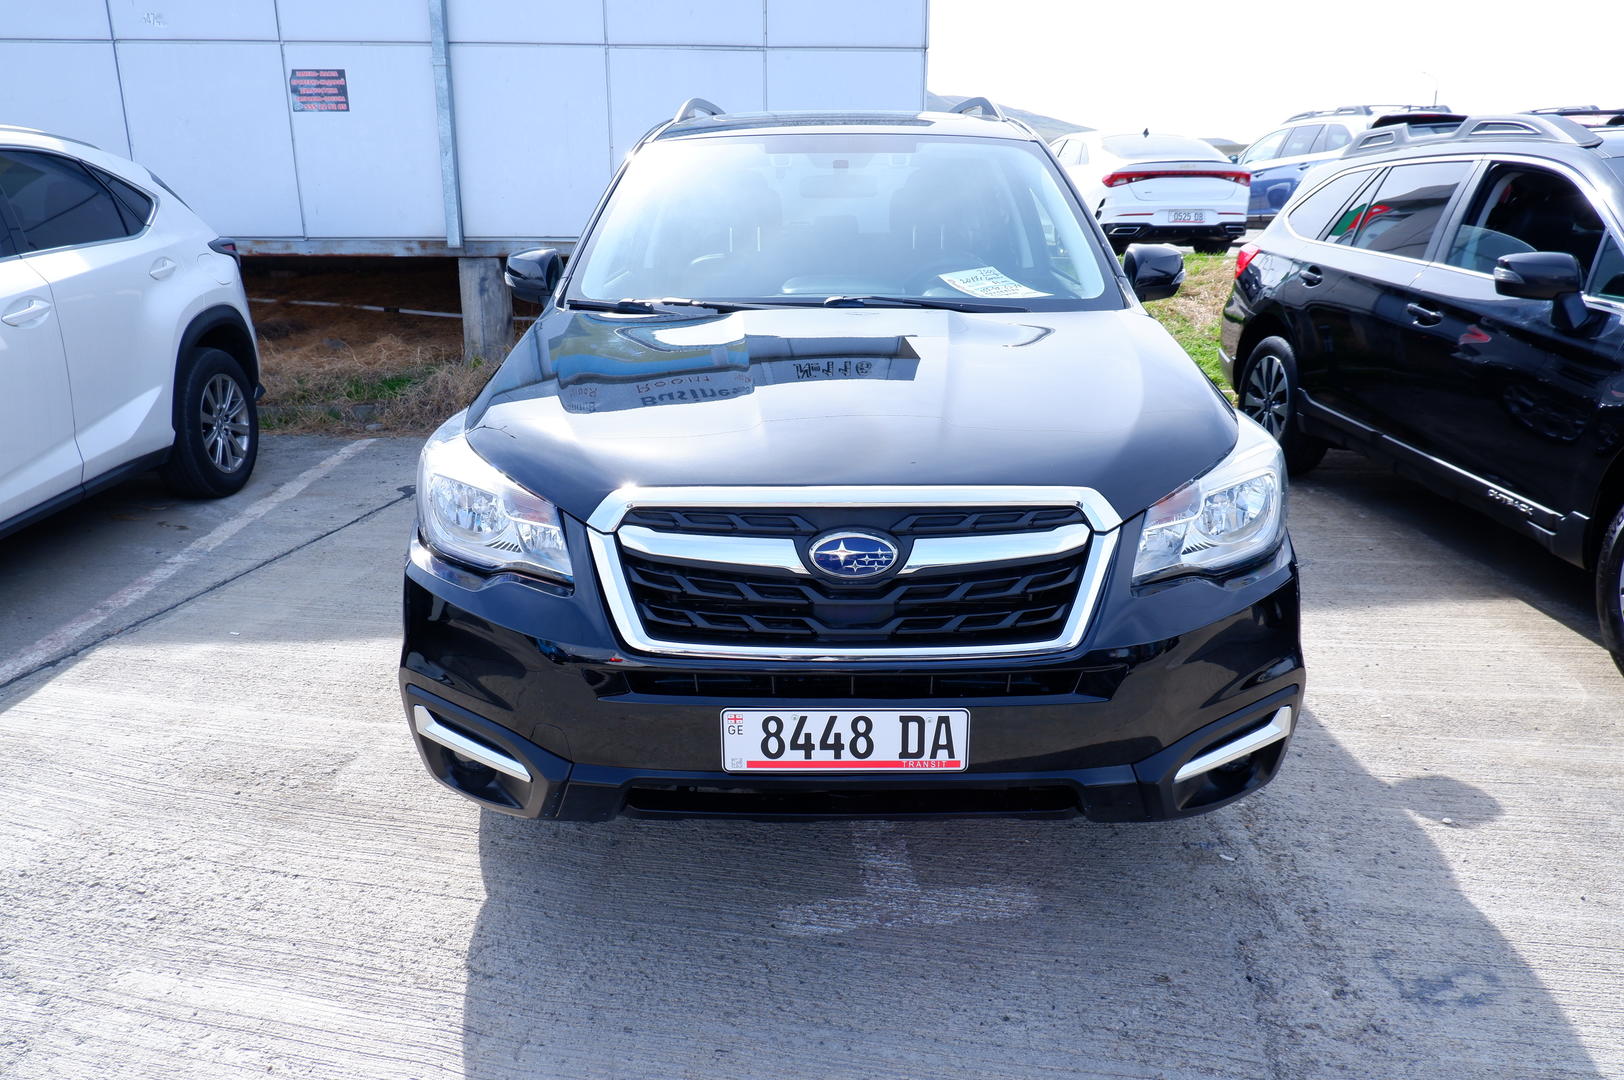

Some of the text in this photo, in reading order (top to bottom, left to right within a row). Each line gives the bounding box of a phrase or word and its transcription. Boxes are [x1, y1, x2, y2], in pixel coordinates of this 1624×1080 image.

[1488, 489, 1533, 516] OUTBACK
[728, 725, 744, 736] GE
[760, 715, 955, 760] 8448 DA
[902, 761, 947, 769] TRANSIT
